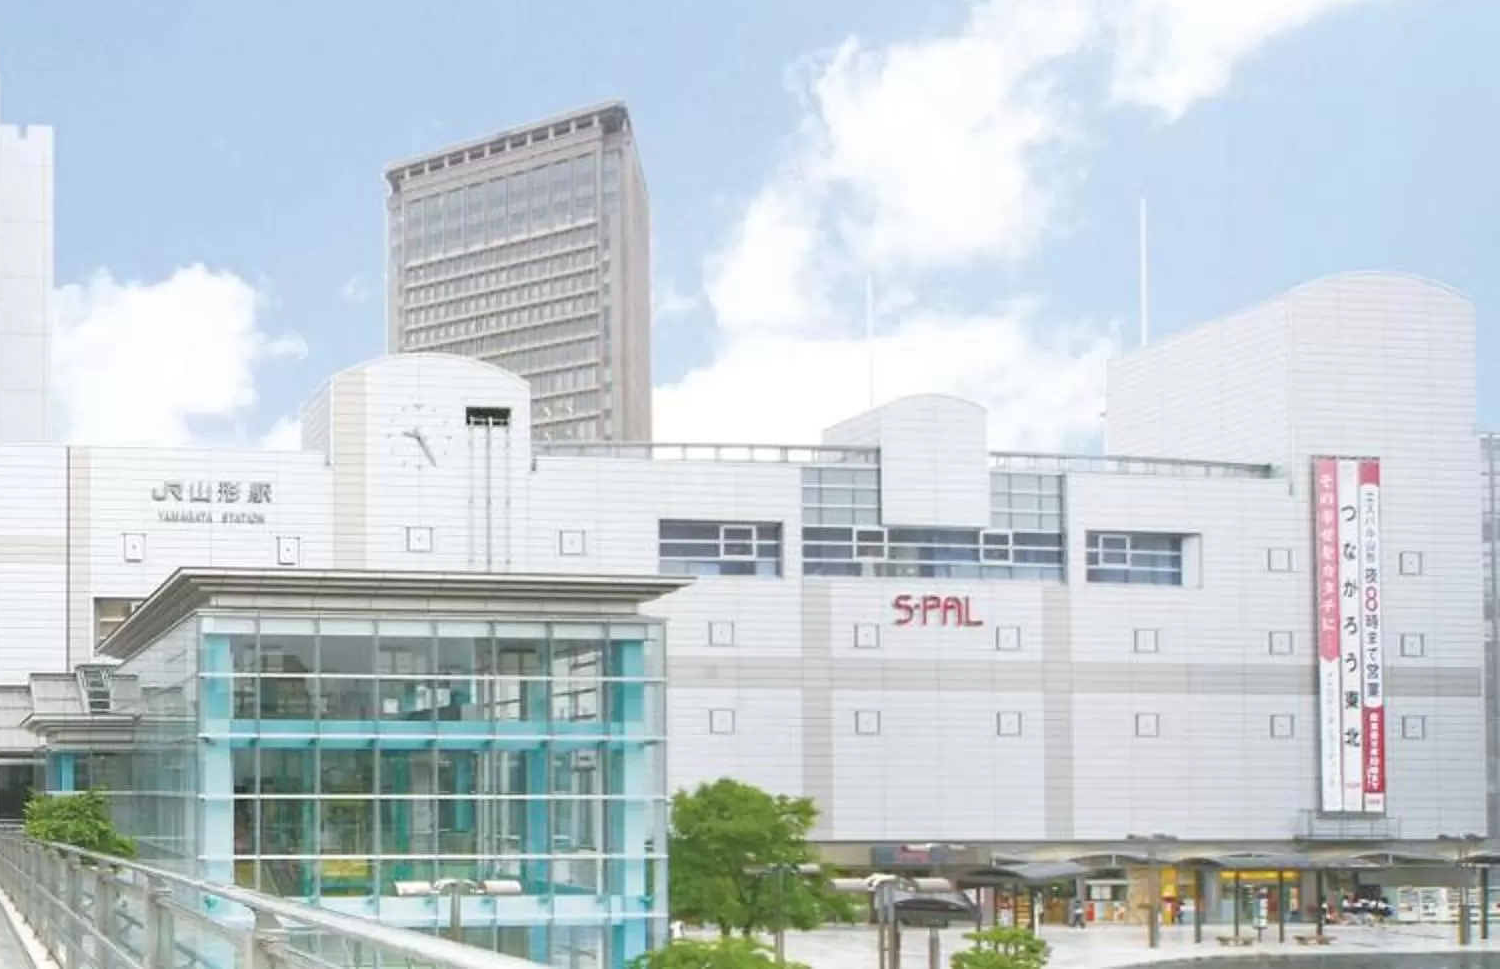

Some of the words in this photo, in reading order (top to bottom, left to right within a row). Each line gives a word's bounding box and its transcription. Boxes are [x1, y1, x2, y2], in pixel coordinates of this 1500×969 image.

[151, 480, 273, 504] JR山形駅
[157, 510, 213, 524] YAMAGATA
[221, 511, 265, 525] STATION
[1340, 504, 1361, 748] つながろう東北
